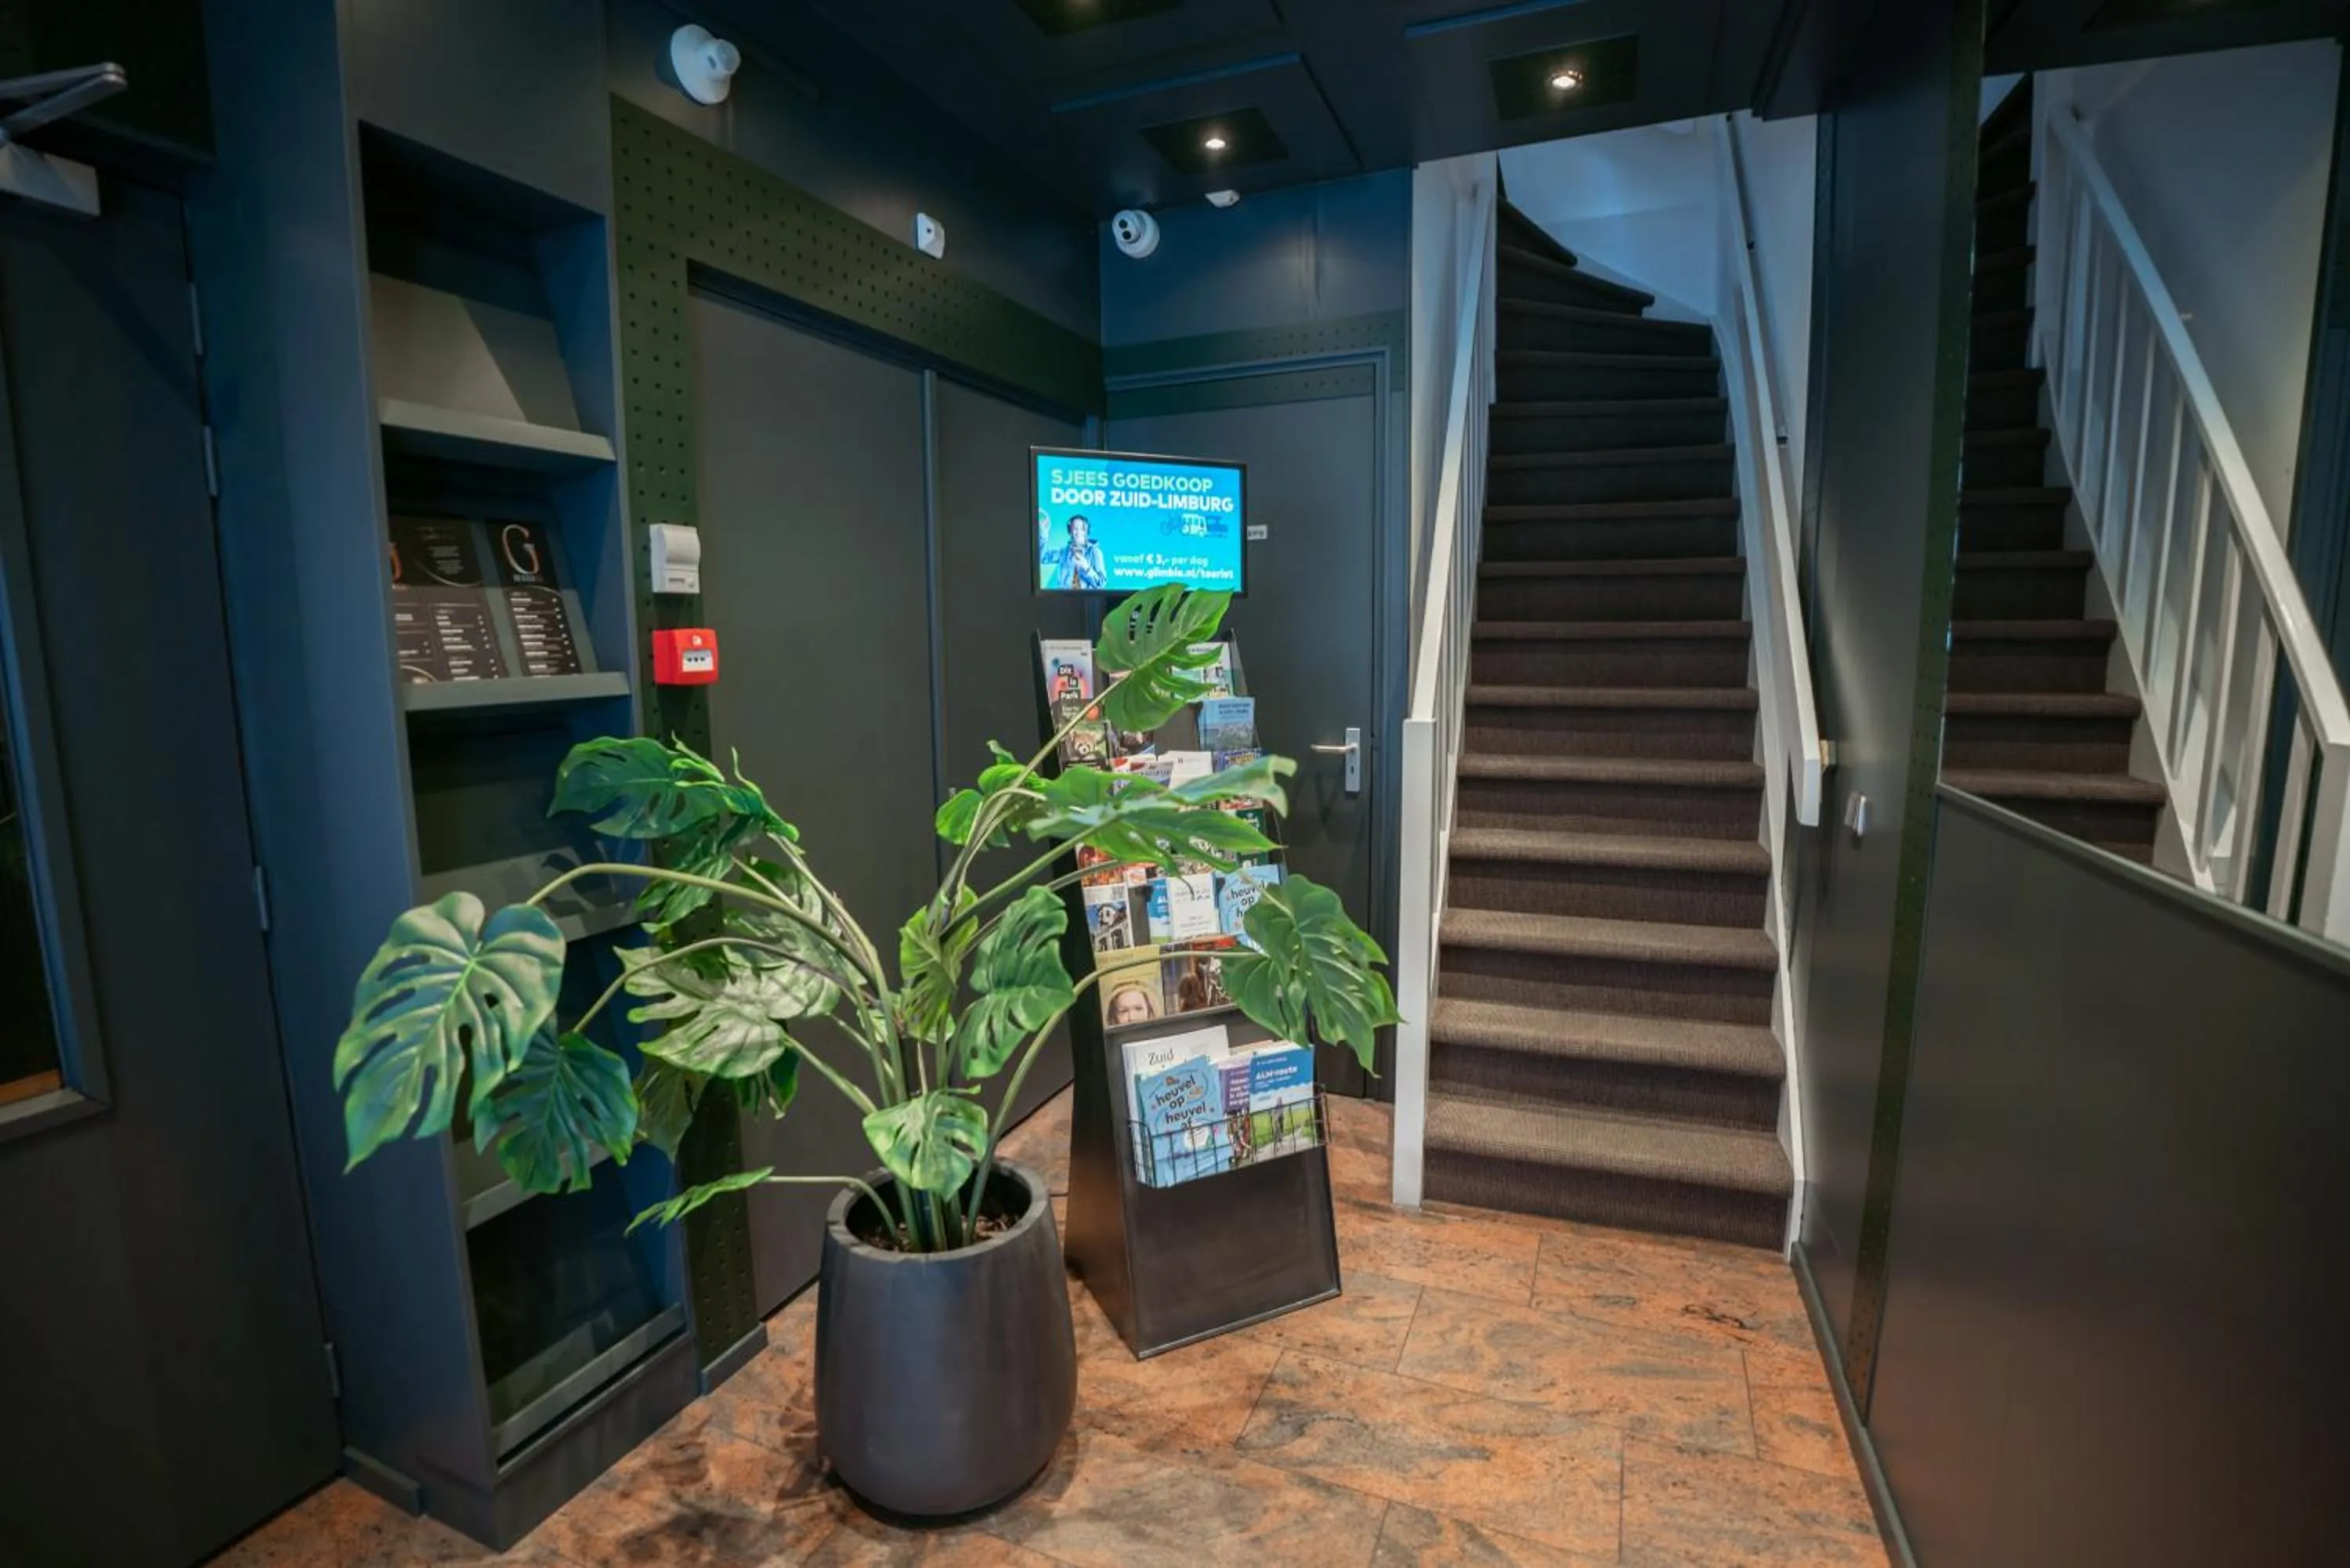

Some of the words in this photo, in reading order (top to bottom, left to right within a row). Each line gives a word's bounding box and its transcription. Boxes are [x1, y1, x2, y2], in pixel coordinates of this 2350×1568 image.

[1051, 469, 1108, 487] SJEES
[1113, 473, 1213, 492] GOEDKOOP
[1051, 488, 1105, 505] DOOR
[1109, 491, 1234, 512] ZUID-LIMBURG
[1113, 554, 1144, 563] vanaf
[1171, 556, 1188, 567] per
[1189, 555, 1209, 567] dag
[1155, 1072, 1195, 1106] heuvel
[1166, 1101, 1206, 1124] heuvel
[1170, 1097, 1185, 1109] op
